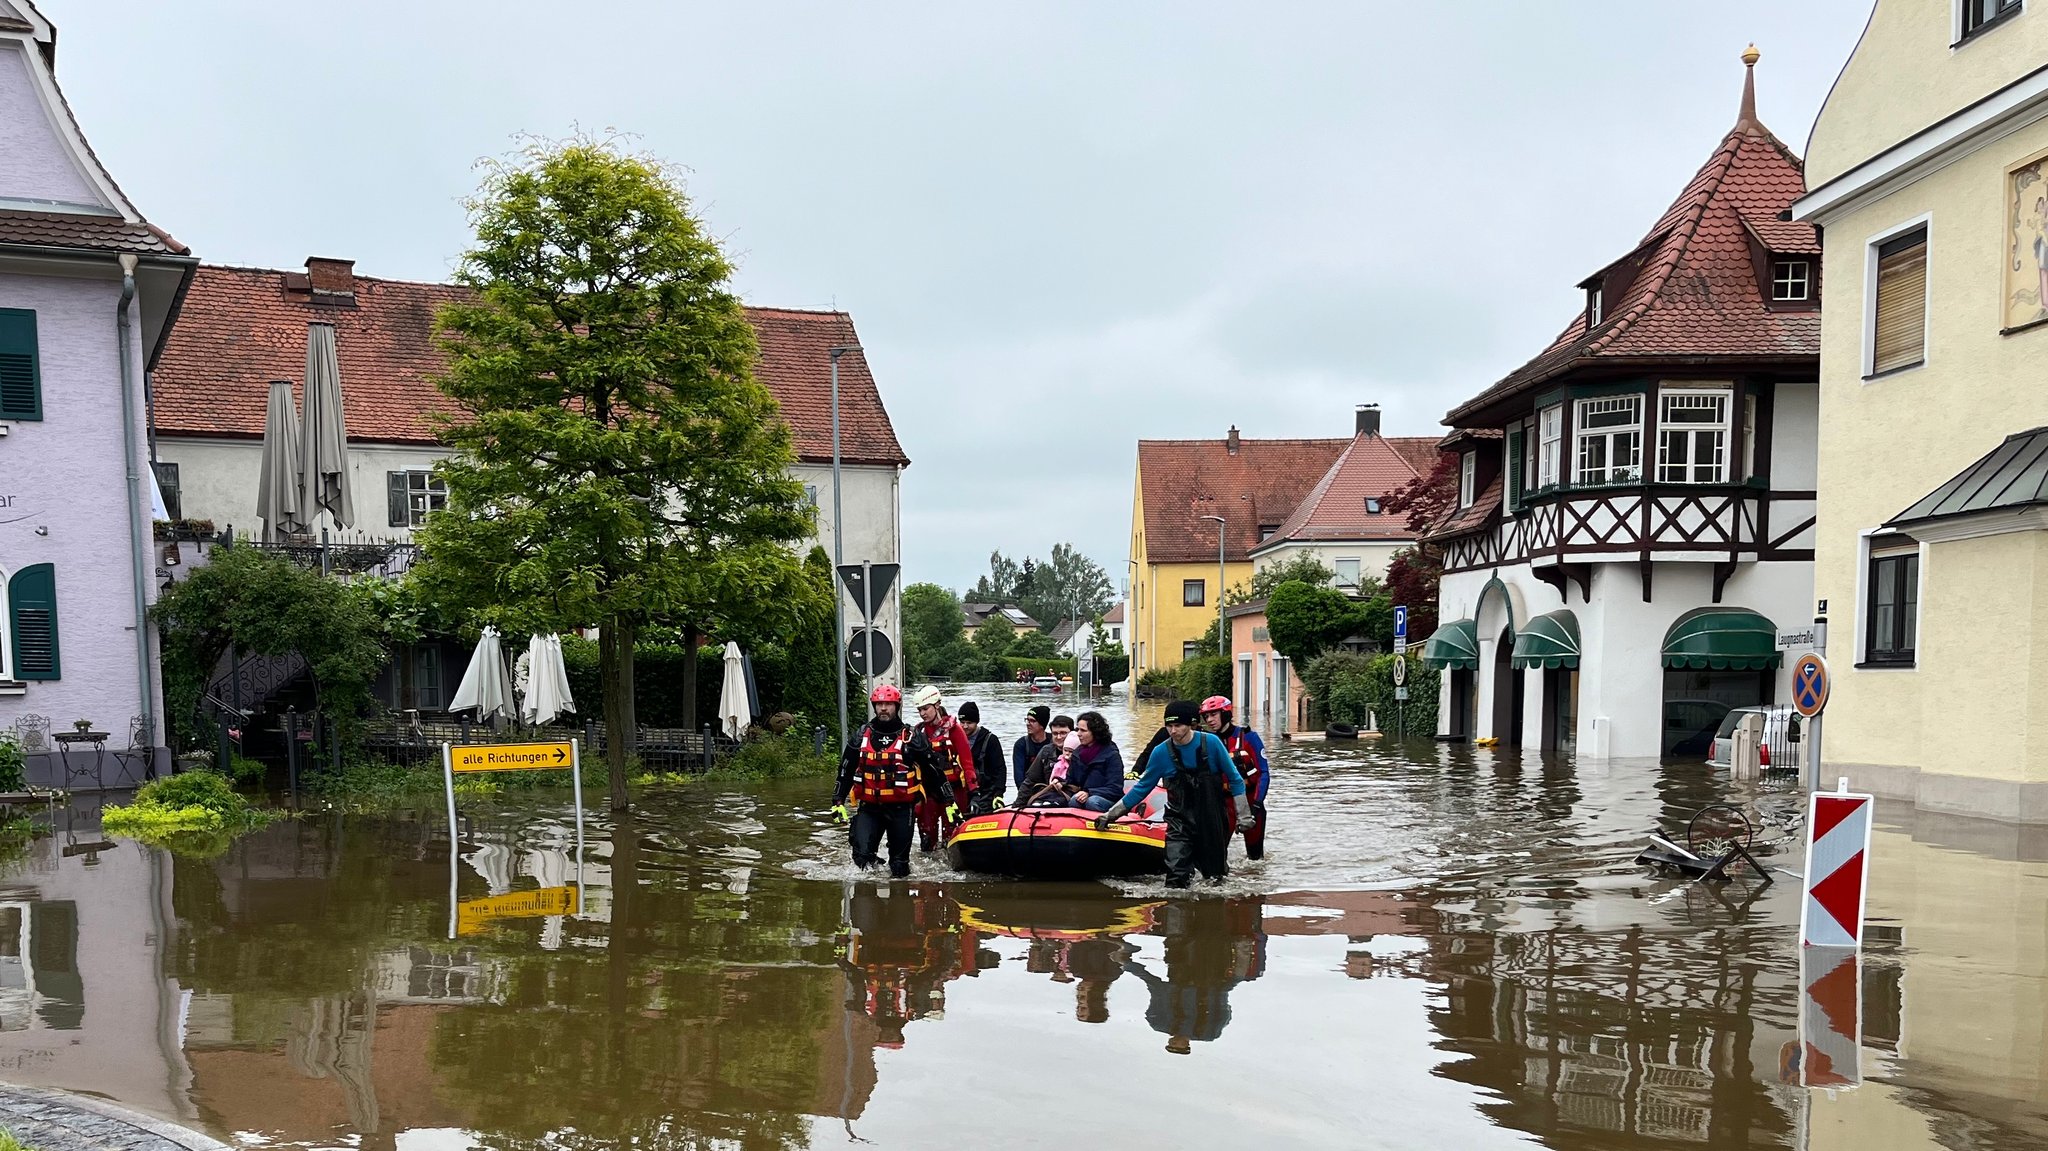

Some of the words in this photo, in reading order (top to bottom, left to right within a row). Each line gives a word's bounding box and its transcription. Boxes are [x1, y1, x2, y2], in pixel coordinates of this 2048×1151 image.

[1396, 610, 1404, 633] P
[1778, 630, 1814, 648] Laugnastraße
[463, 755, 483, 764] alle
[488, 753, 548, 764] Richtungen
